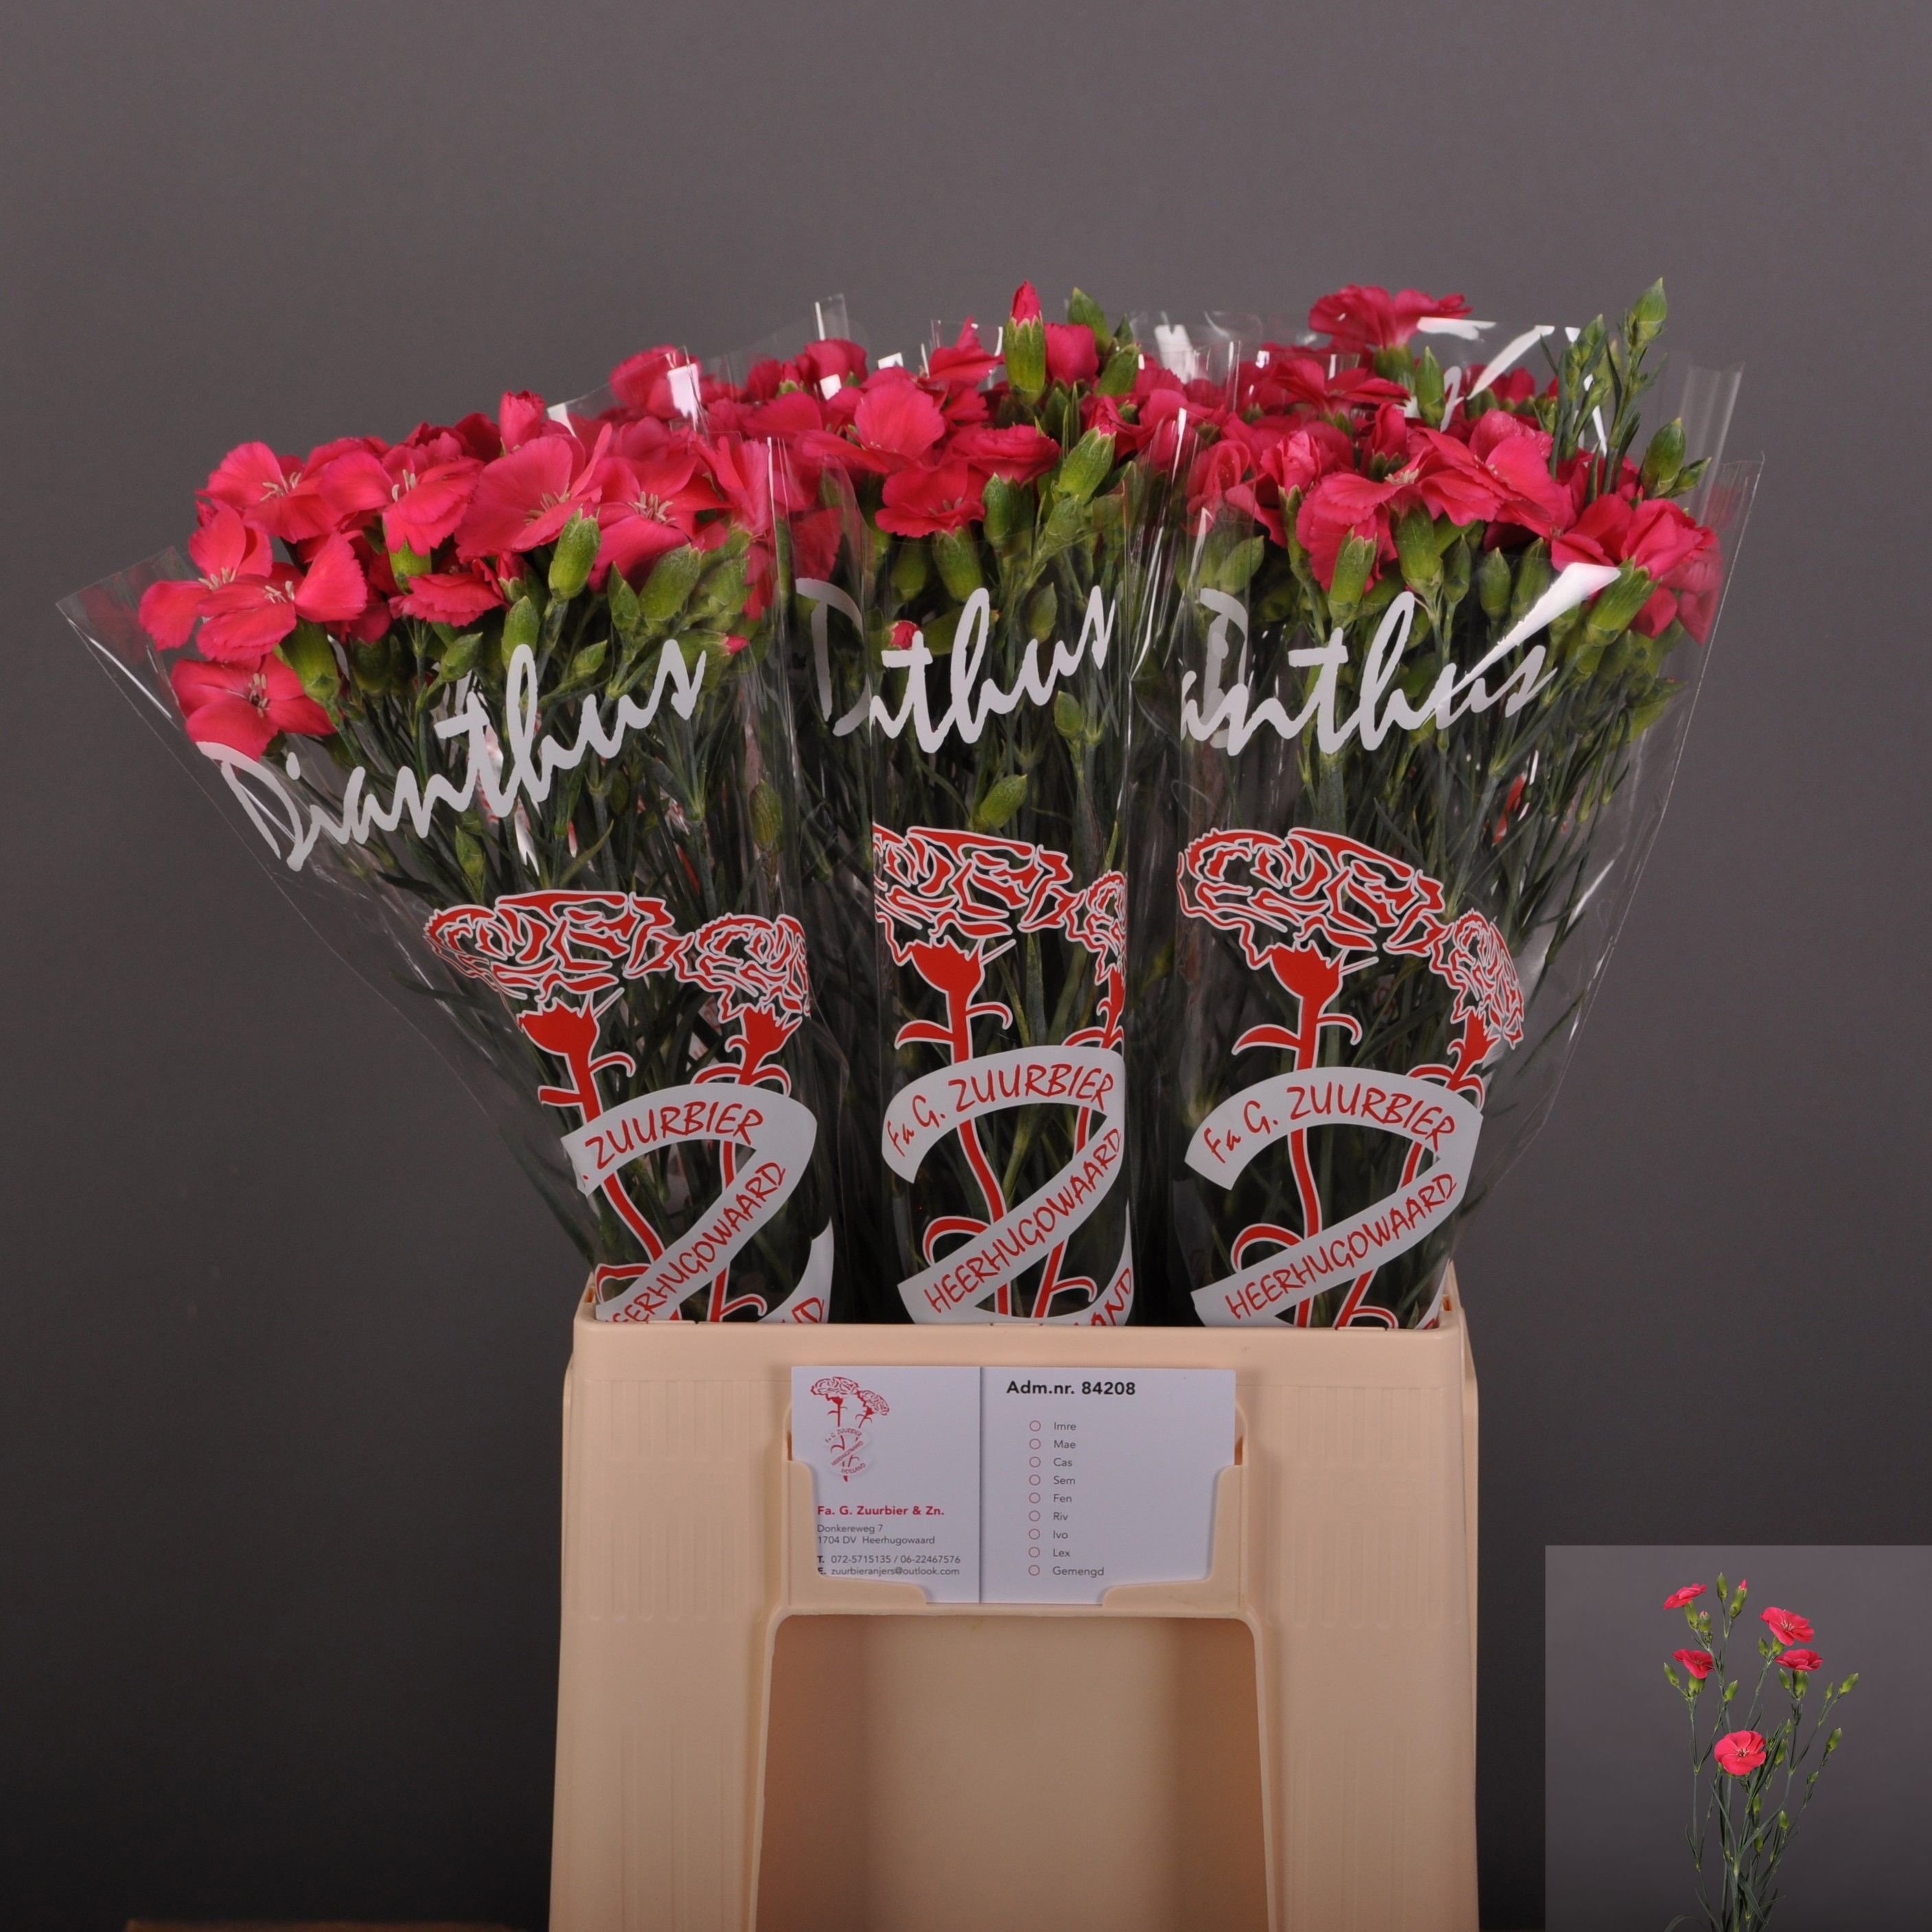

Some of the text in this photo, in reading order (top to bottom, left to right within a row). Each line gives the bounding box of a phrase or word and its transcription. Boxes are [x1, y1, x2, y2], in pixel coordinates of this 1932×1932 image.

[196, 639, 706, 872] Dianthus
[912, 1094, 945, 1128] G.
[947, 1063, 1114, 1111] ZUURBIER
[1243, 1100, 1279, 1134] G.
[1286, 1081, 1456, 1151] ZUURBIER
[584, 1101, 764, 1170] ZUURBIER
[923, 1128, 1121, 1313] HEERHUGOWAARD
[605, 1162, 786, 1323] EERHUGOWAARD
[1225, 1173, 1458, 1320] HEERHUGOWAARD
[1006, 1380, 1136, 1396] Adm.nr. 84208
[1054, 1421, 1077, 1431] Imre
[1053, 1440, 1077, 1449] Mae
[1053, 1458, 1072, 1467] Cas
[1053, 1475, 1076, 1485] Sem
[1053, 1493, 1072, 1503] Fen
[817, 1505, 945, 1516] Fa. G. Zuurbier & Zn.
[1053, 1512, 1068, 1521] Riv
[817, 1523, 884, 1534] Donkereweg 7
[1053, 1530, 1068, 1539] Ivo
[818, 1535, 935, 1546] 1704 DV Heerhugowaard
[1053, 1548, 1070, 1557] Lex
[816, 1555, 825, 1564] T.
[831, 1554, 891, 1564] 072-5715135
[900, 1554, 961, 1564] 06-22467576
[831, 1567, 960, 1577] zuurbieranjers@outlook.com
[1053, 1566, 1105, 1578] Gemengd
